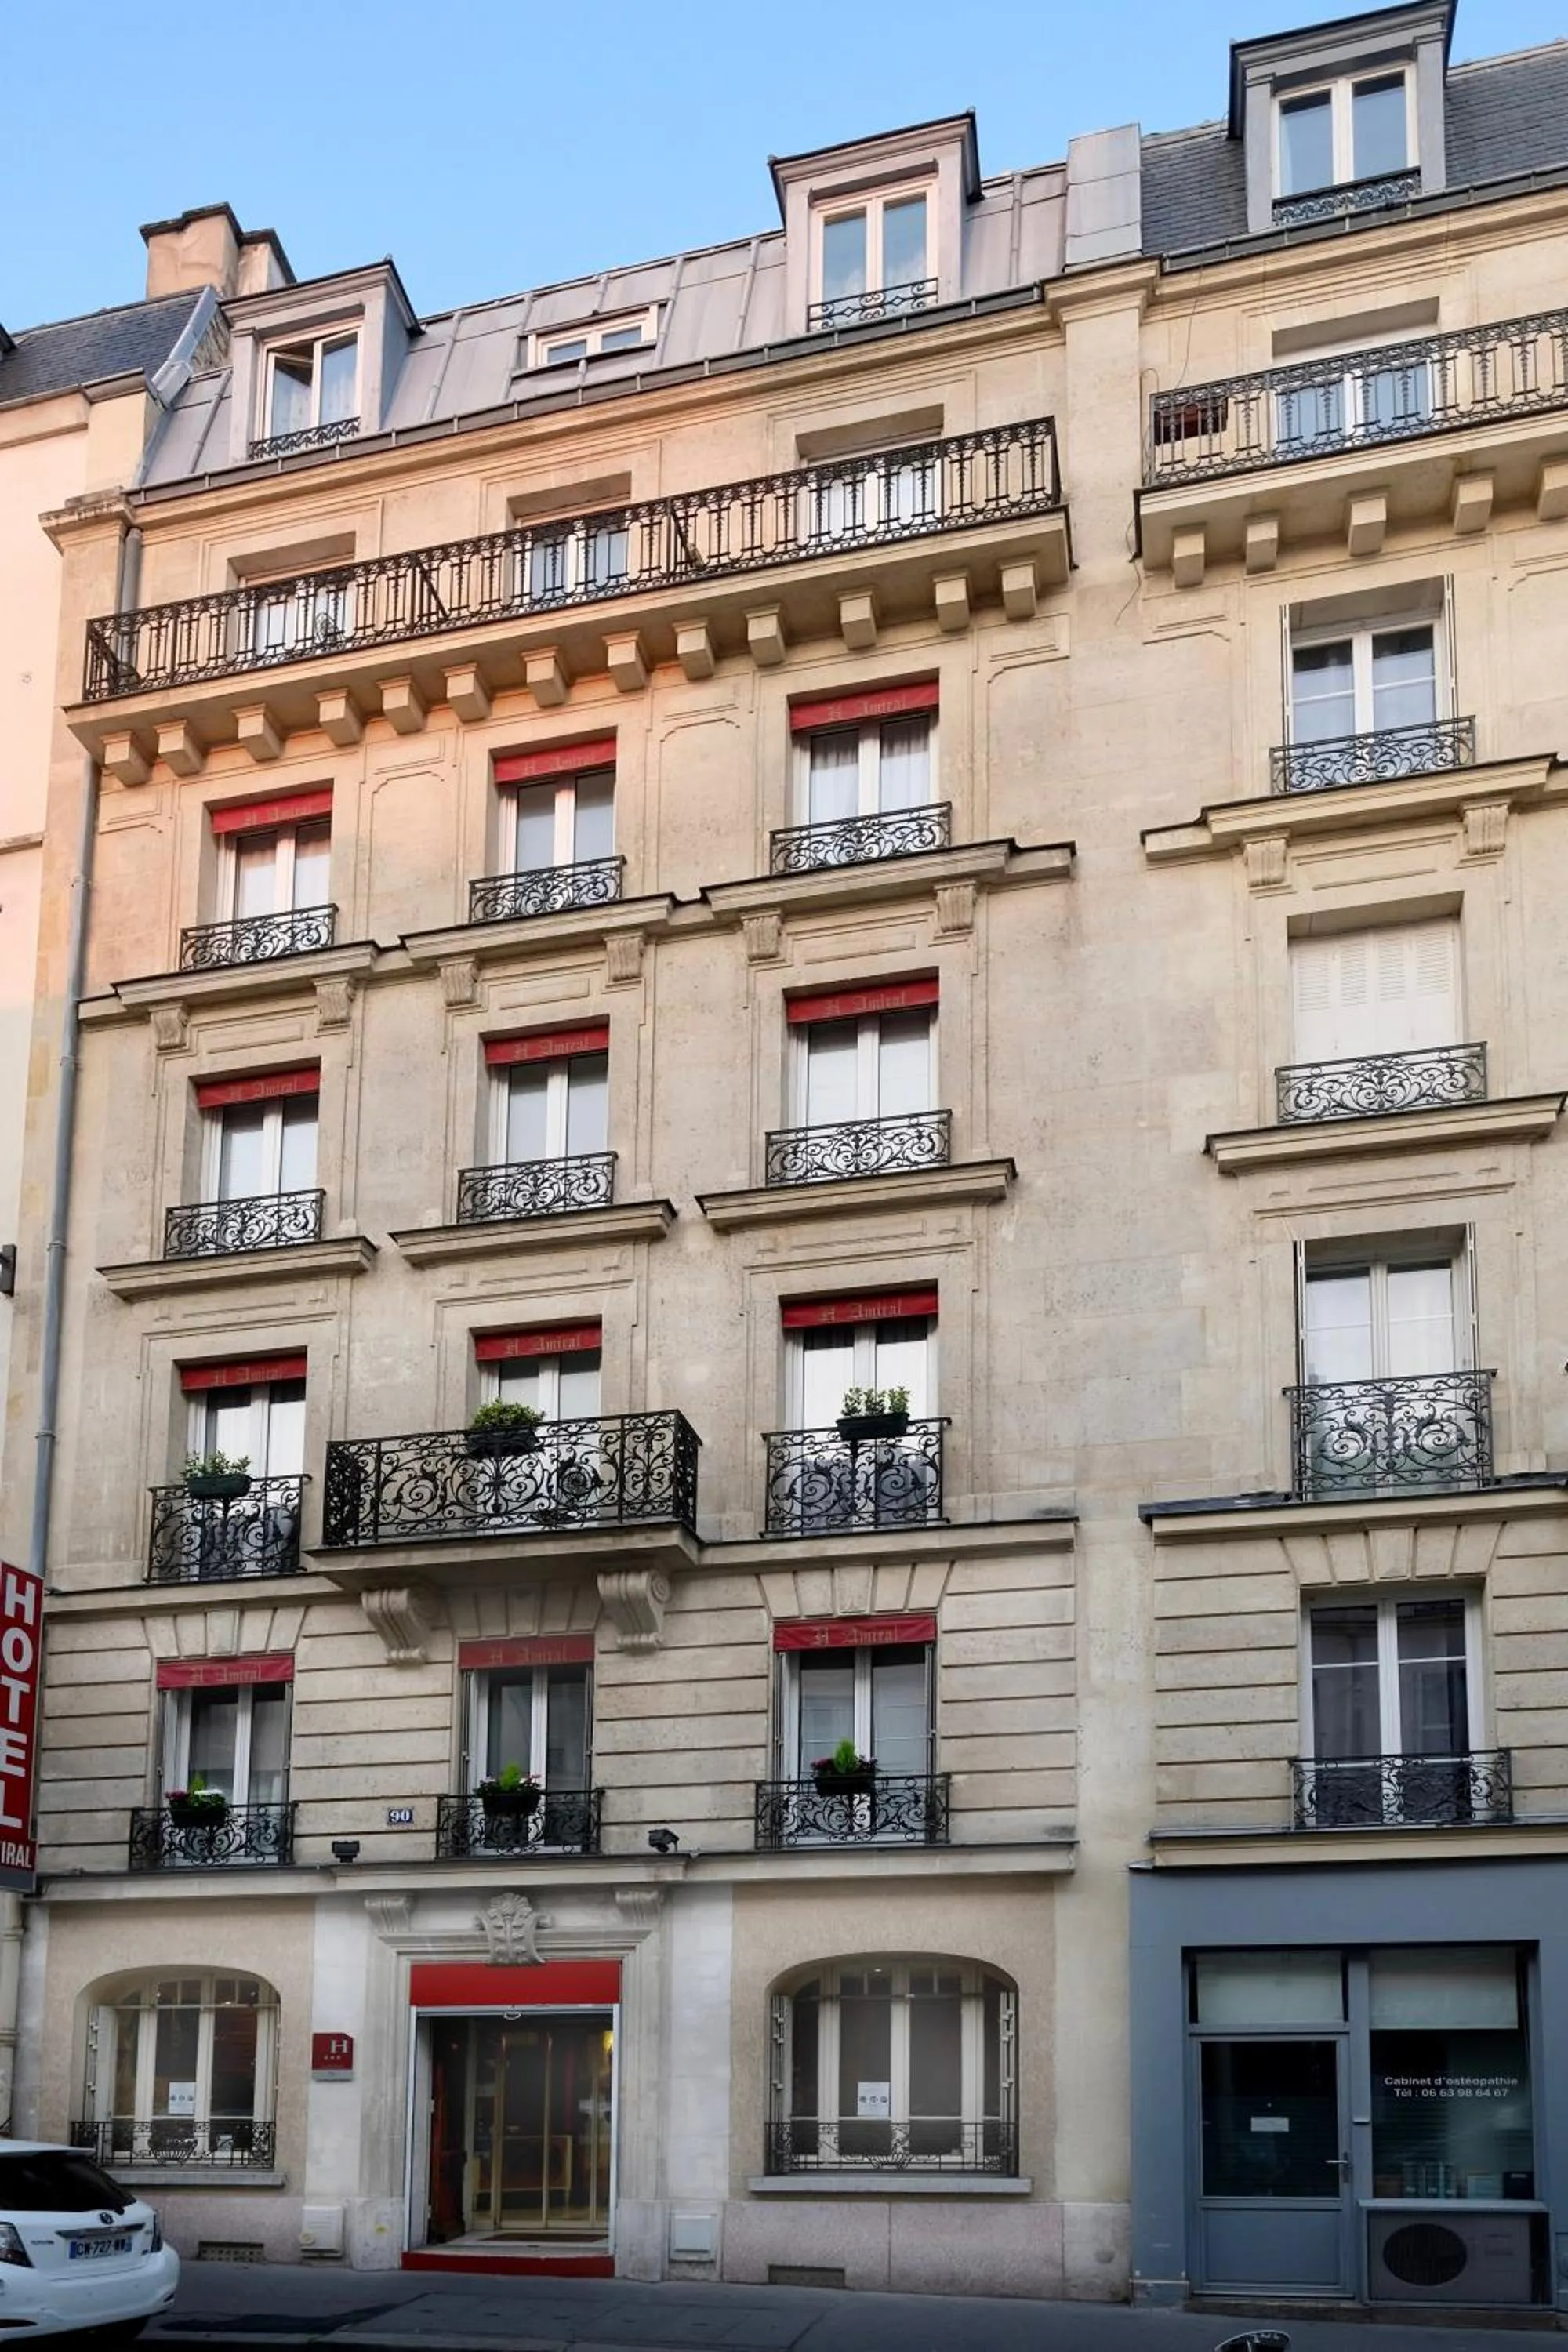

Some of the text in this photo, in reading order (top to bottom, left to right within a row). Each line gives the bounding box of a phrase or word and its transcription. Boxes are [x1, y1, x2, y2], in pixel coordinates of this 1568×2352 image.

[0, 1573, 35, 1829] HOTEL
[390, 1809, 410, 1822] 90
[1, 1840, 32, 1868] IRAL
[331, 2039, 347, 2053] H
[1384, 2077, 1431, 2085] Cabinet
